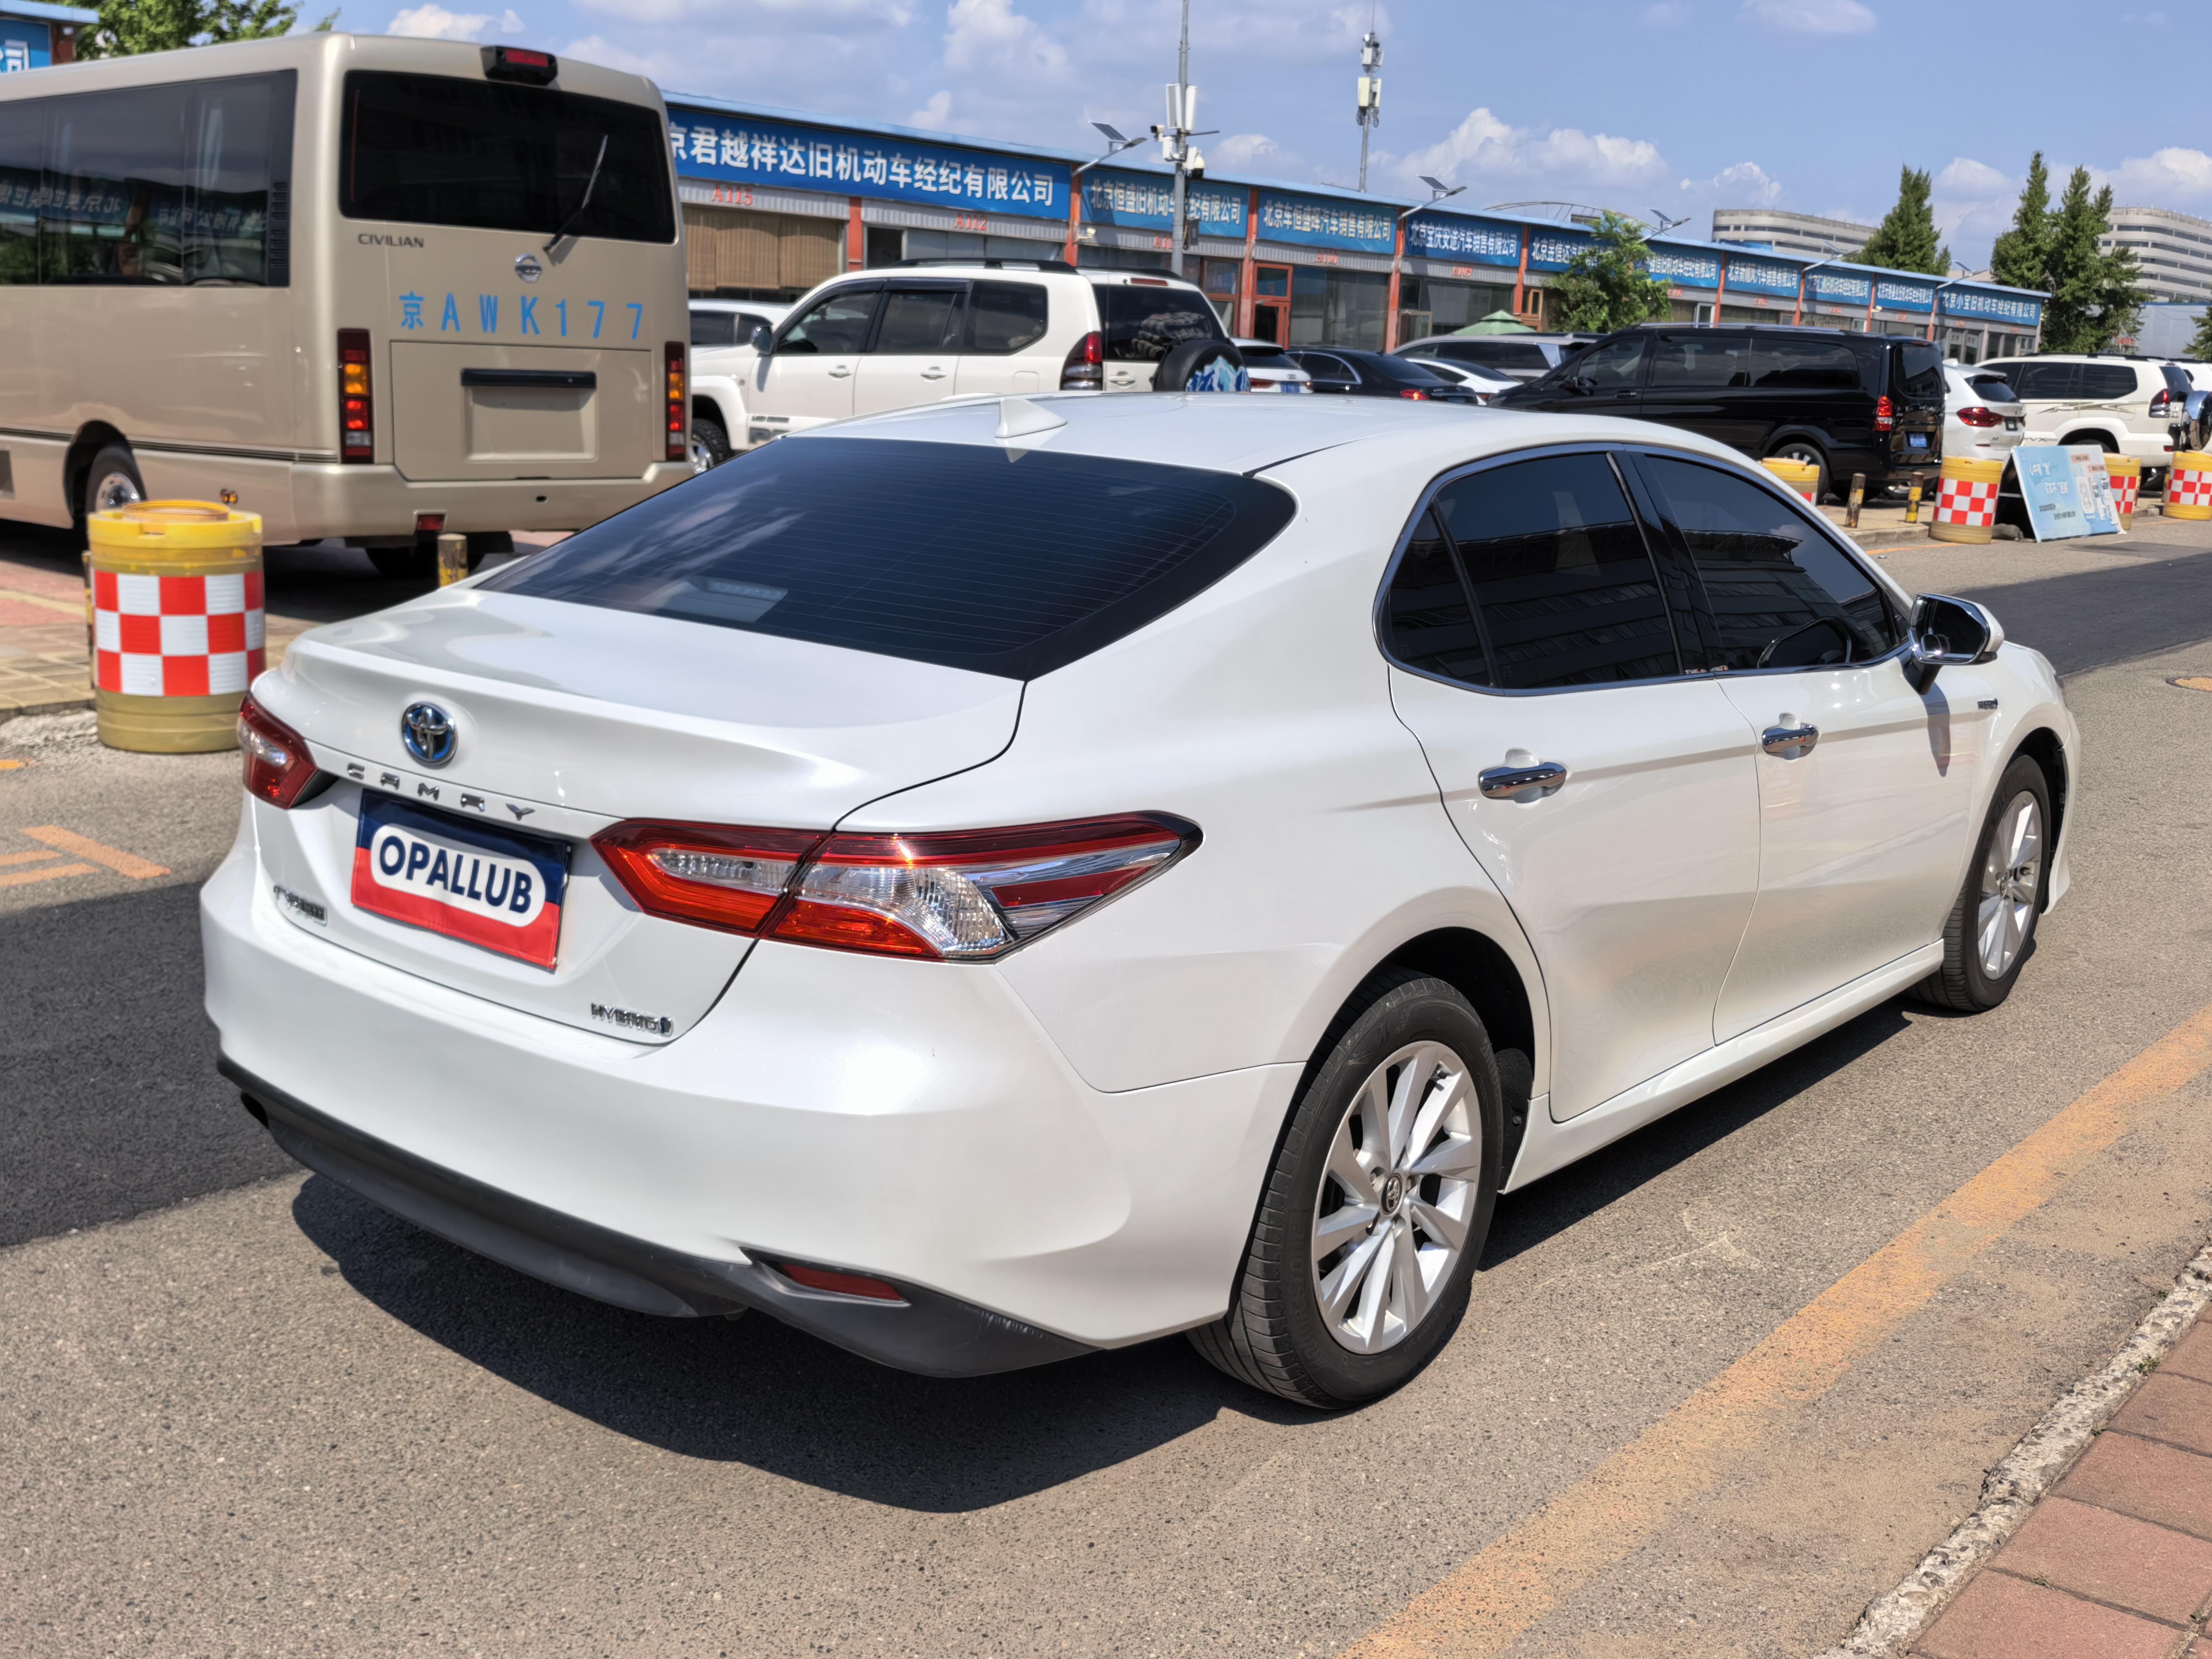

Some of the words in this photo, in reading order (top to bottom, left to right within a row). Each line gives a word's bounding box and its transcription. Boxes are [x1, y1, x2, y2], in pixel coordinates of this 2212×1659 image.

[0, 38, 29, 73] 司
[669, 122, 1053, 207] 京君越祥达旧机动车经纪有限公司
[711, 183, 753, 205] A115
[954, 212, 987, 230] A112
[358, 233, 424, 248] CIVILIAN
[1154, 235, 1172, 249] A11
[399, 291, 642, 339] 京AWK177
[347, 762, 535, 821] CAMRY
[379, 834, 532, 914] OPALLUB
